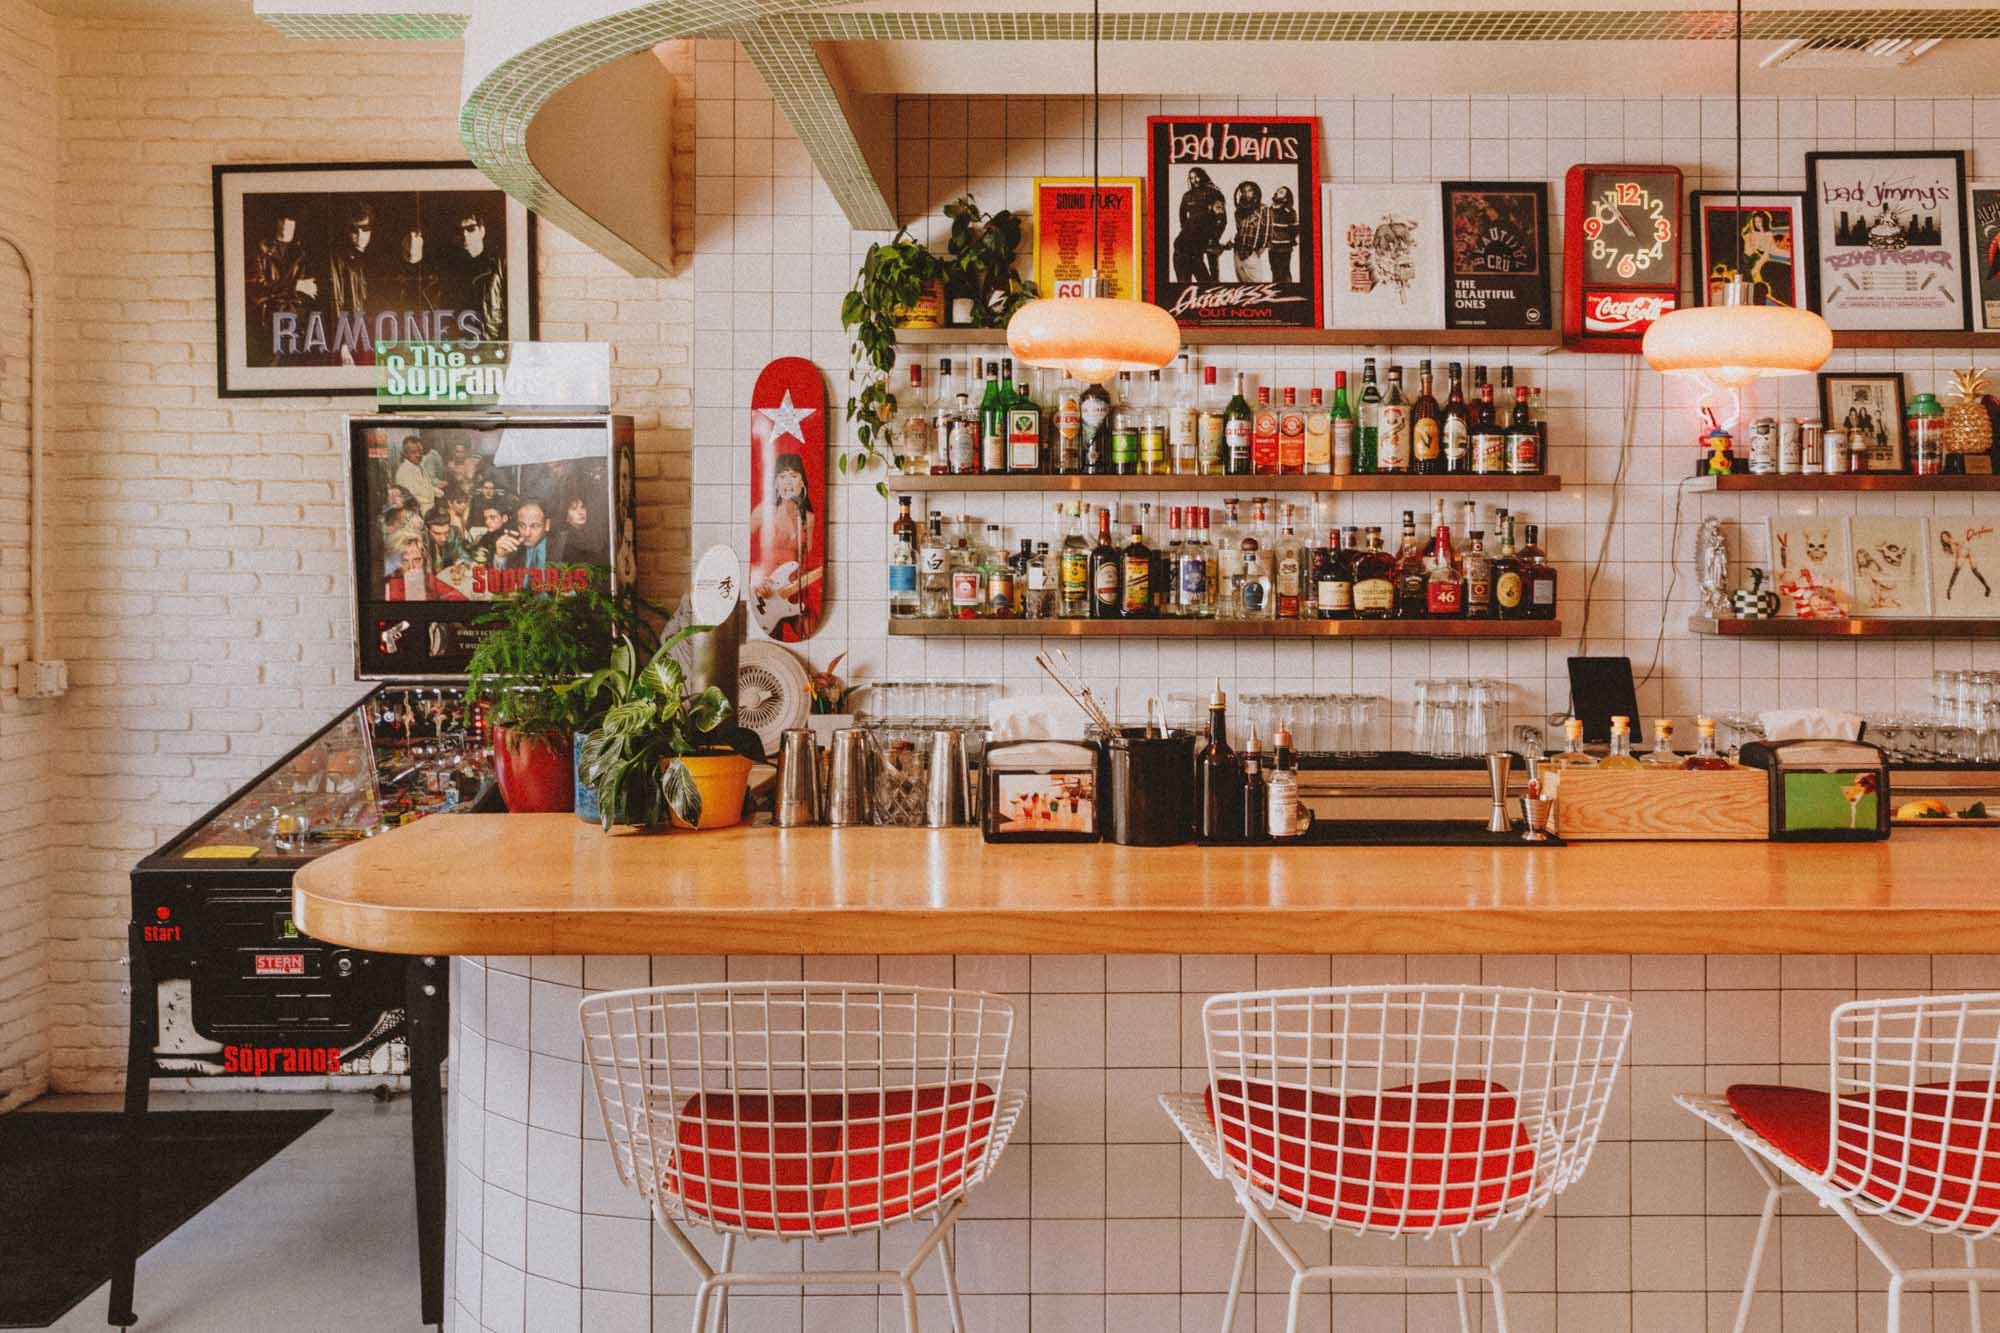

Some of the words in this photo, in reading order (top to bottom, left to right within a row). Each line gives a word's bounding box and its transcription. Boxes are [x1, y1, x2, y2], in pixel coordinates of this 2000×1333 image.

[1169, 122, 1215, 163] bad
[1219, 123, 1299, 162] brains
[1616, 182, 1641, 206] 12
[1640, 190, 1649, 210] 1
[1823, 181, 1864, 204] bad
[1592, 200, 1618, 225] 10
[1649, 199, 1665, 219] 2
[1583, 216, 1603, 240] 9
[1653, 218, 1671, 242] 3
[1591, 239, 1606, 261] 8
[1605, 247, 1619, 269] 7
[1635, 248, 1651, 270] 5
[1648, 239, 1664, 261] 4
[1616, 253, 1637, 278] 6
[1455, 279, 1477, 289] THE
[1455, 290, 1517, 299] BEAUTIFUL
[1199, 307, 1227, 318] OUT
[1230, 307, 1272, 318] NOW!
[1455, 300, 1487, 310] ONES
[272, 310, 484, 353] RAMONES
[410, 345, 466, 368] The
[386, 354, 535, 401] Sopran
[1437, 591, 1456, 603] 46
[257, 956, 302, 969] STERN
